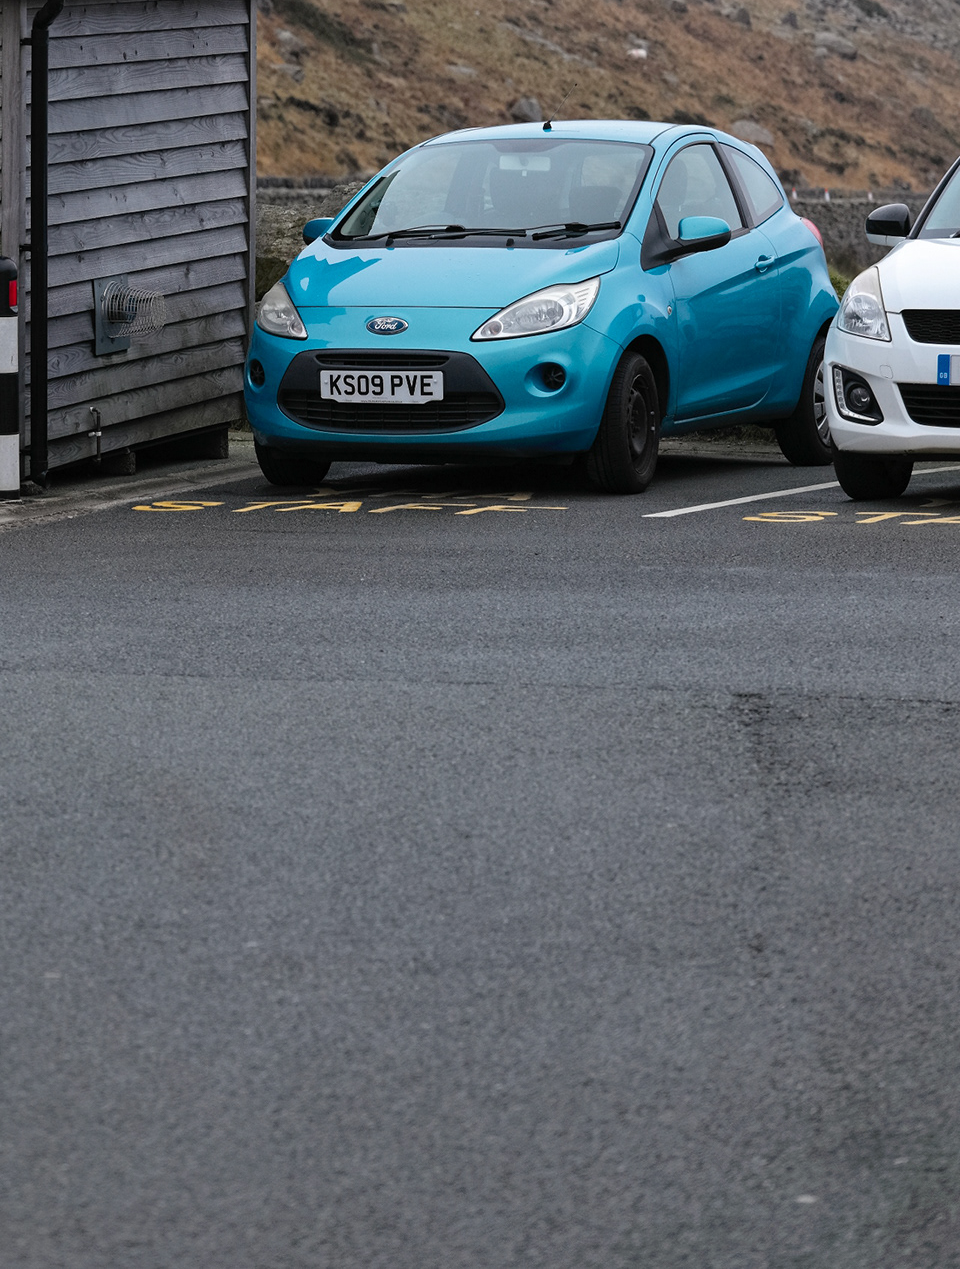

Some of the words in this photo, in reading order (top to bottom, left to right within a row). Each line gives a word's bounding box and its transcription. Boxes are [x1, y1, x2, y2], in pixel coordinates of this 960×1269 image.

[374, 319, 398, 330] Ford
[329, 374, 384, 396] KS09
[390, 374, 434, 396] PVE
[131, 500, 569, 515] STAFF
